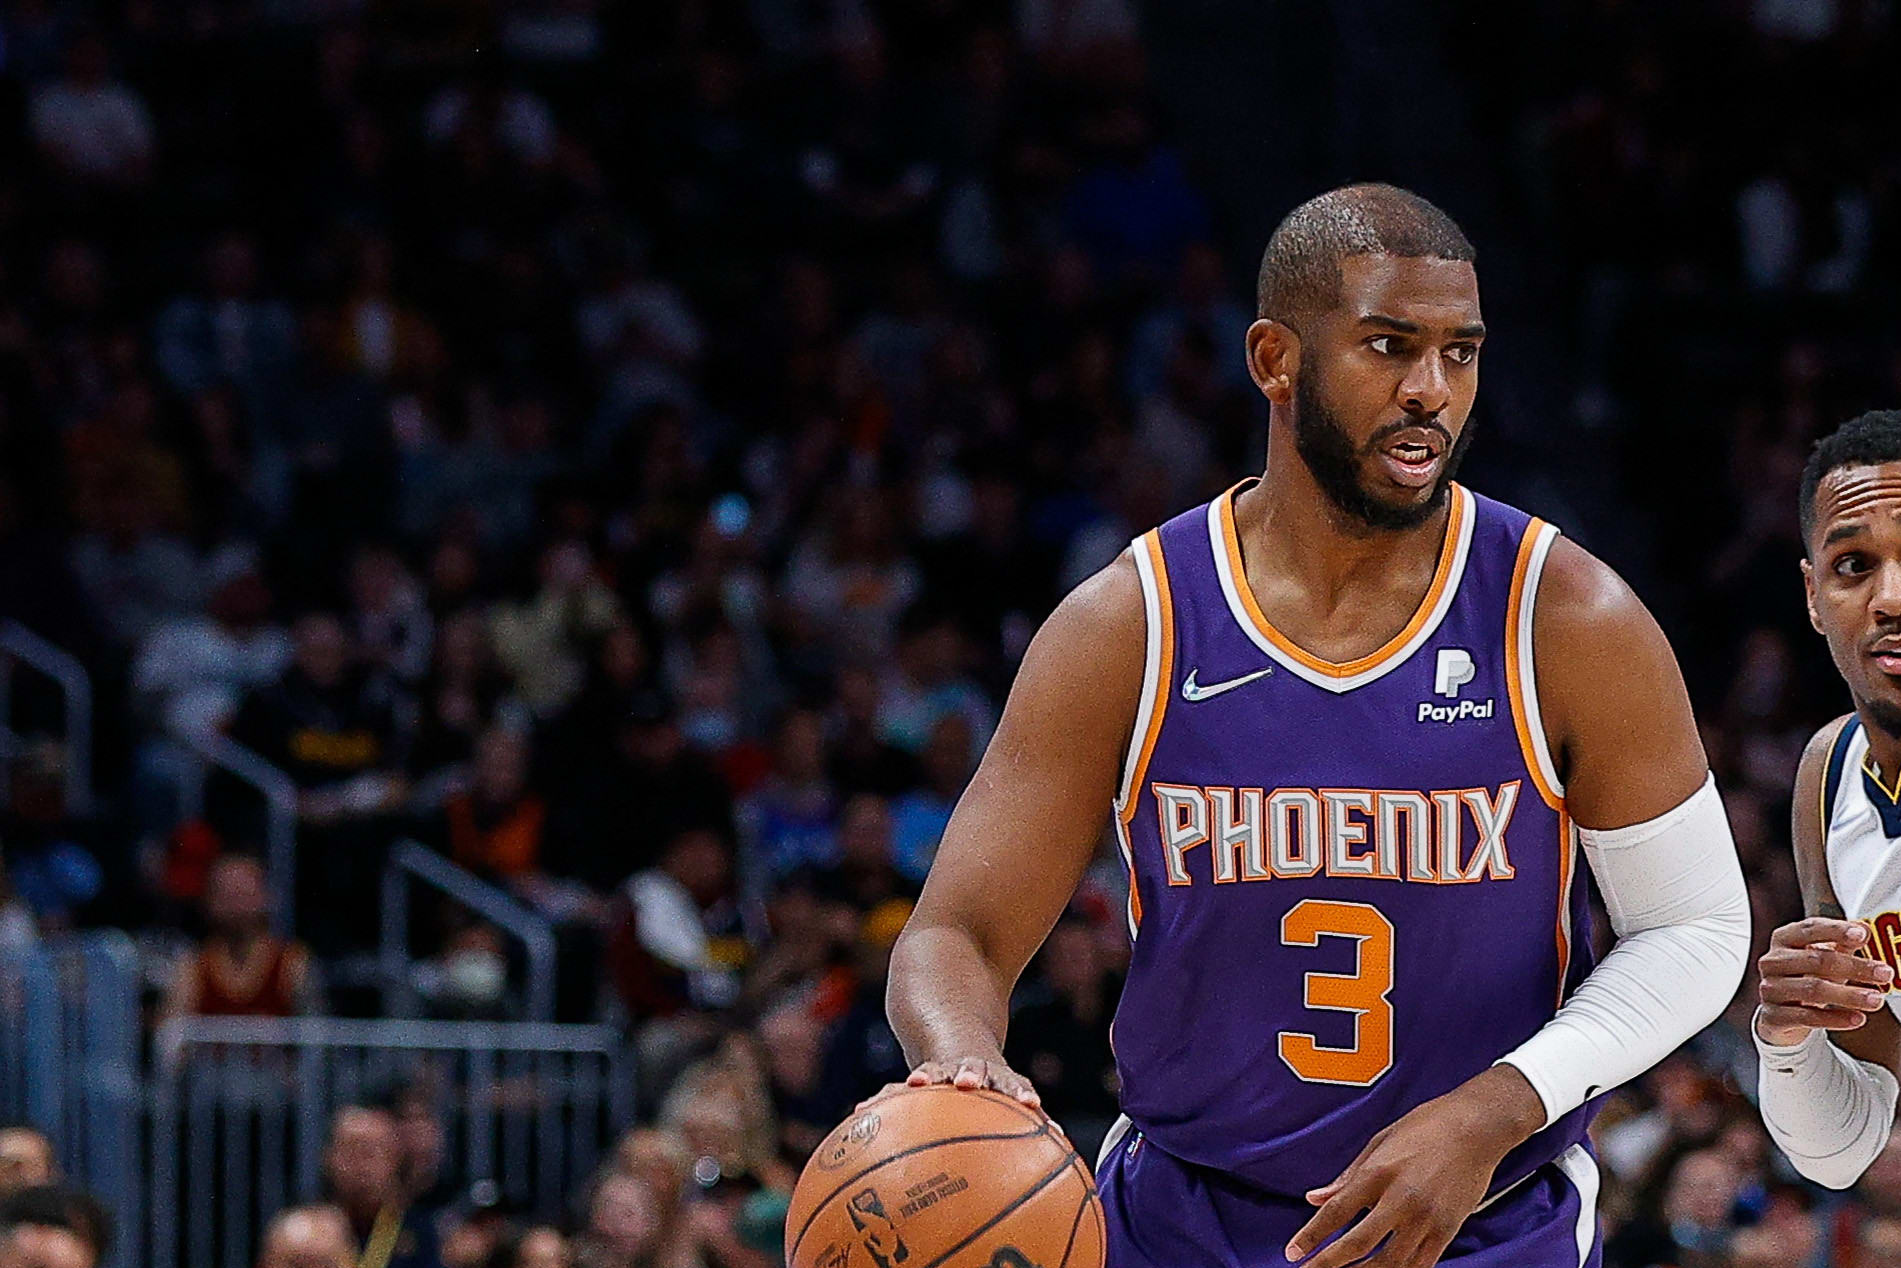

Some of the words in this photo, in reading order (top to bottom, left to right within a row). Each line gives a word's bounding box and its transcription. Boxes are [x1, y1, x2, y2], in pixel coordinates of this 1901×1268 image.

[1418, 699, 1494, 723] PayPal
[1151, 779, 1522, 887] PHOENIX
[1278, 898, 1396, 1087] 3
